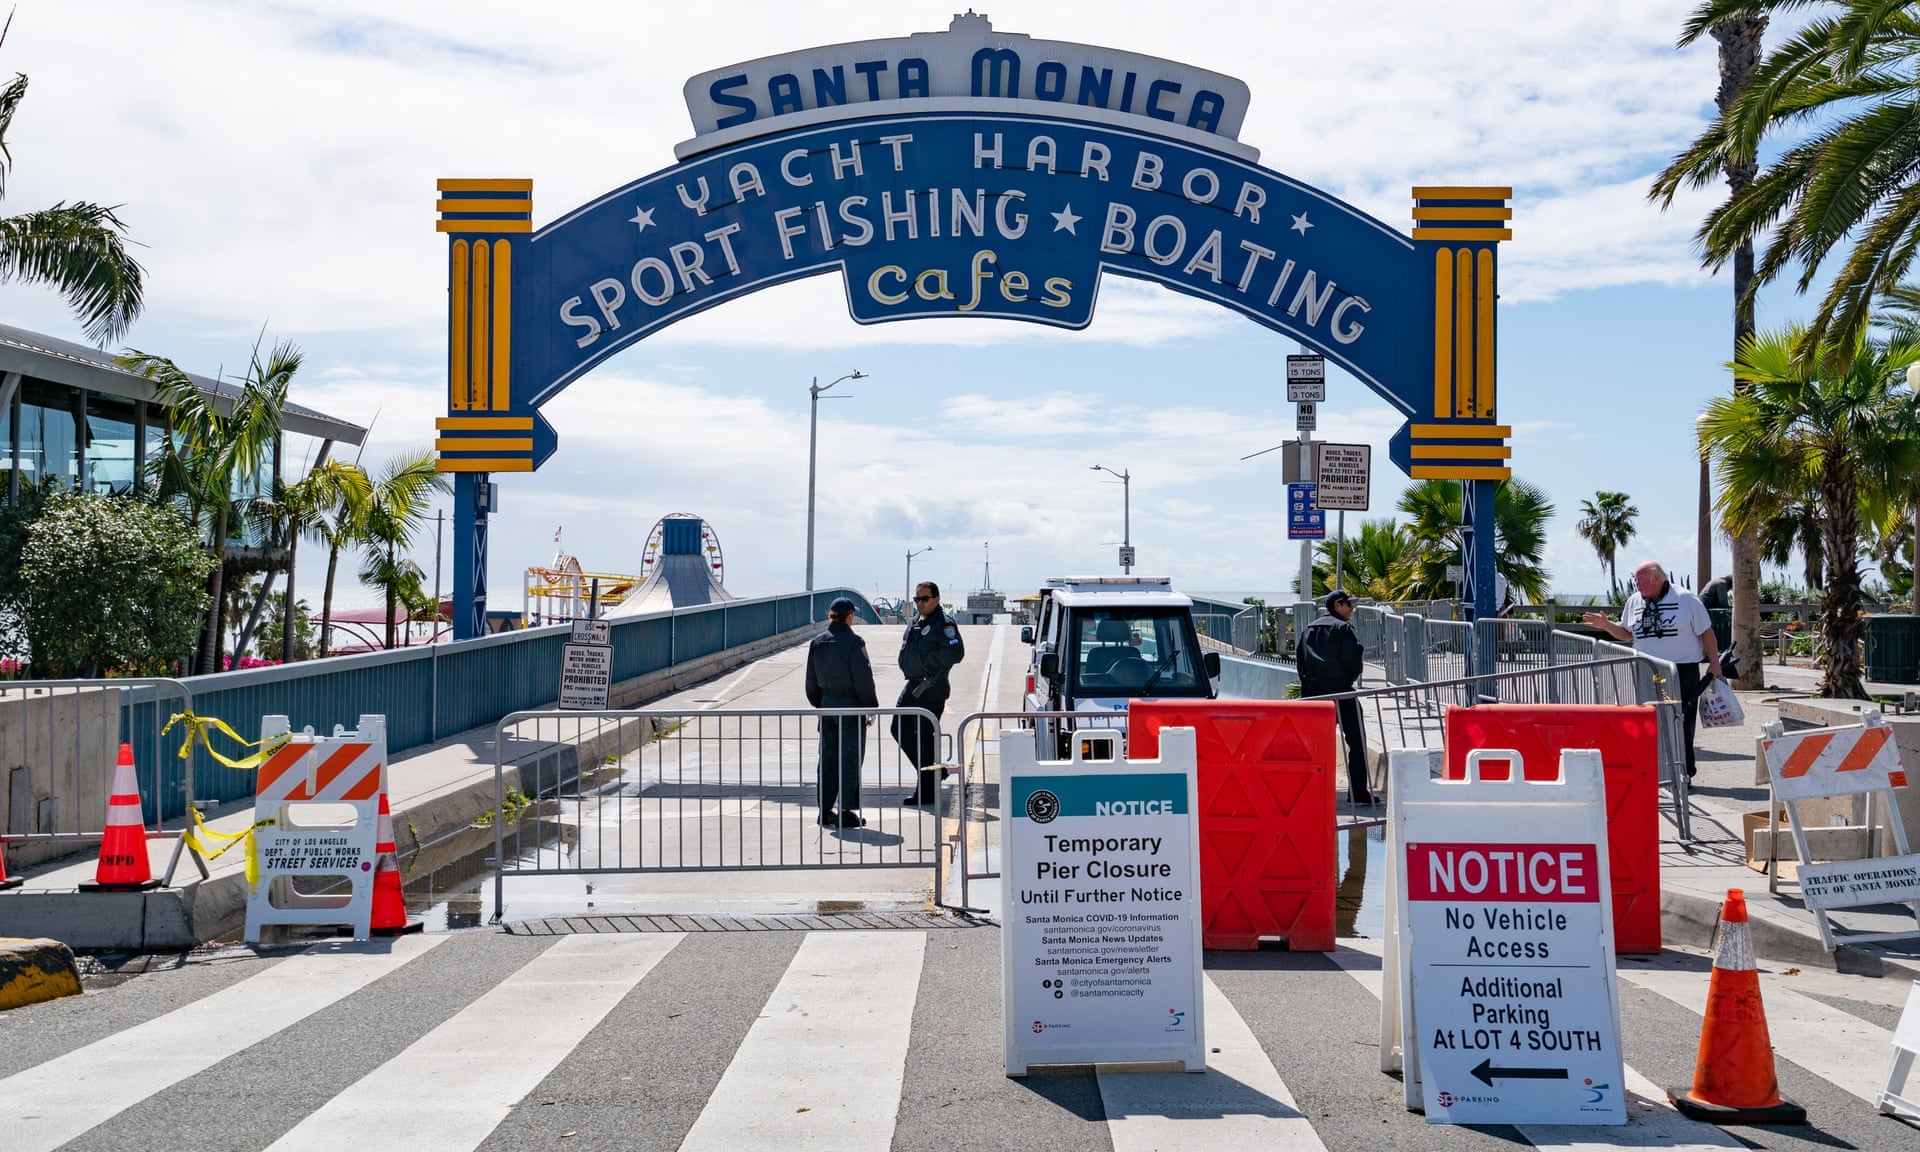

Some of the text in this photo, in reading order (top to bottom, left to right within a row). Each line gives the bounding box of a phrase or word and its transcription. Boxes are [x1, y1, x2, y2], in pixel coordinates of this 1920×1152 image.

[709, 47, 1225, 134] SANTA MONICA
[676, 132, 1267, 224] YACHT HARBOR
[559, 188, 1372, 349] SPORT FISHING BOATING
[1301, 368, 1321, 376] TONS
[1292, 391, 1320, 399] 3 TONS
[1300, 404, 1313, 414] NO
[1321, 474, 1366, 484] PROHIBITED
[585, 623, 595, 631] USE
[574, 633, 606, 641] CROSSWALK
[564, 675, 607, 685] PROHIBITED
[1096, 800, 1173, 816] NOTICE
[1044, 835, 1162, 856] Temporary
[265, 847, 361, 857] DEPT. OF PUBLIC WORKS
[267, 857, 359, 869] STREET SERVICES
[1037, 861, 1171, 880] Pier Closure
[1428, 850, 1586, 895] NOTICE
[1806, 867, 1917, 886] TRAFFIC OPERATIONS
[1804, 886, 1829, 896] CITY
[1833, 884, 1846, 893] OF
[1850, 881, 1882, 893] SANTA
[1021, 887, 1183, 904] Until Further Notice
[1025, 913, 1179, 924] Santa Monica COVID-19 Information
[1446, 907, 1568, 930] No Vehicle
[1044, 925, 1161, 934] santamonica.gov/coronavirus
[1042, 935, 1164, 944] Santa Monica News Updates
[1047, 946, 1159, 955] santamonica.gov/newsletter
[1467, 936, 1549, 959] Access
[1035, 955, 1172, 966] Santa Monica Emergency Alerts
[1057, 967, 1150, 976] santamonica.gov/alerts
[1070, 978, 1152, 987] @cityofsantamonica
[1461, 977, 1562, 998] Additional
[1070, 989, 1144, 998] @santamonicacity
[1473, 1003, 1550, 1029] Parking
[1433, 1029, 1602, 1051] At LOT 4 SOUTH
